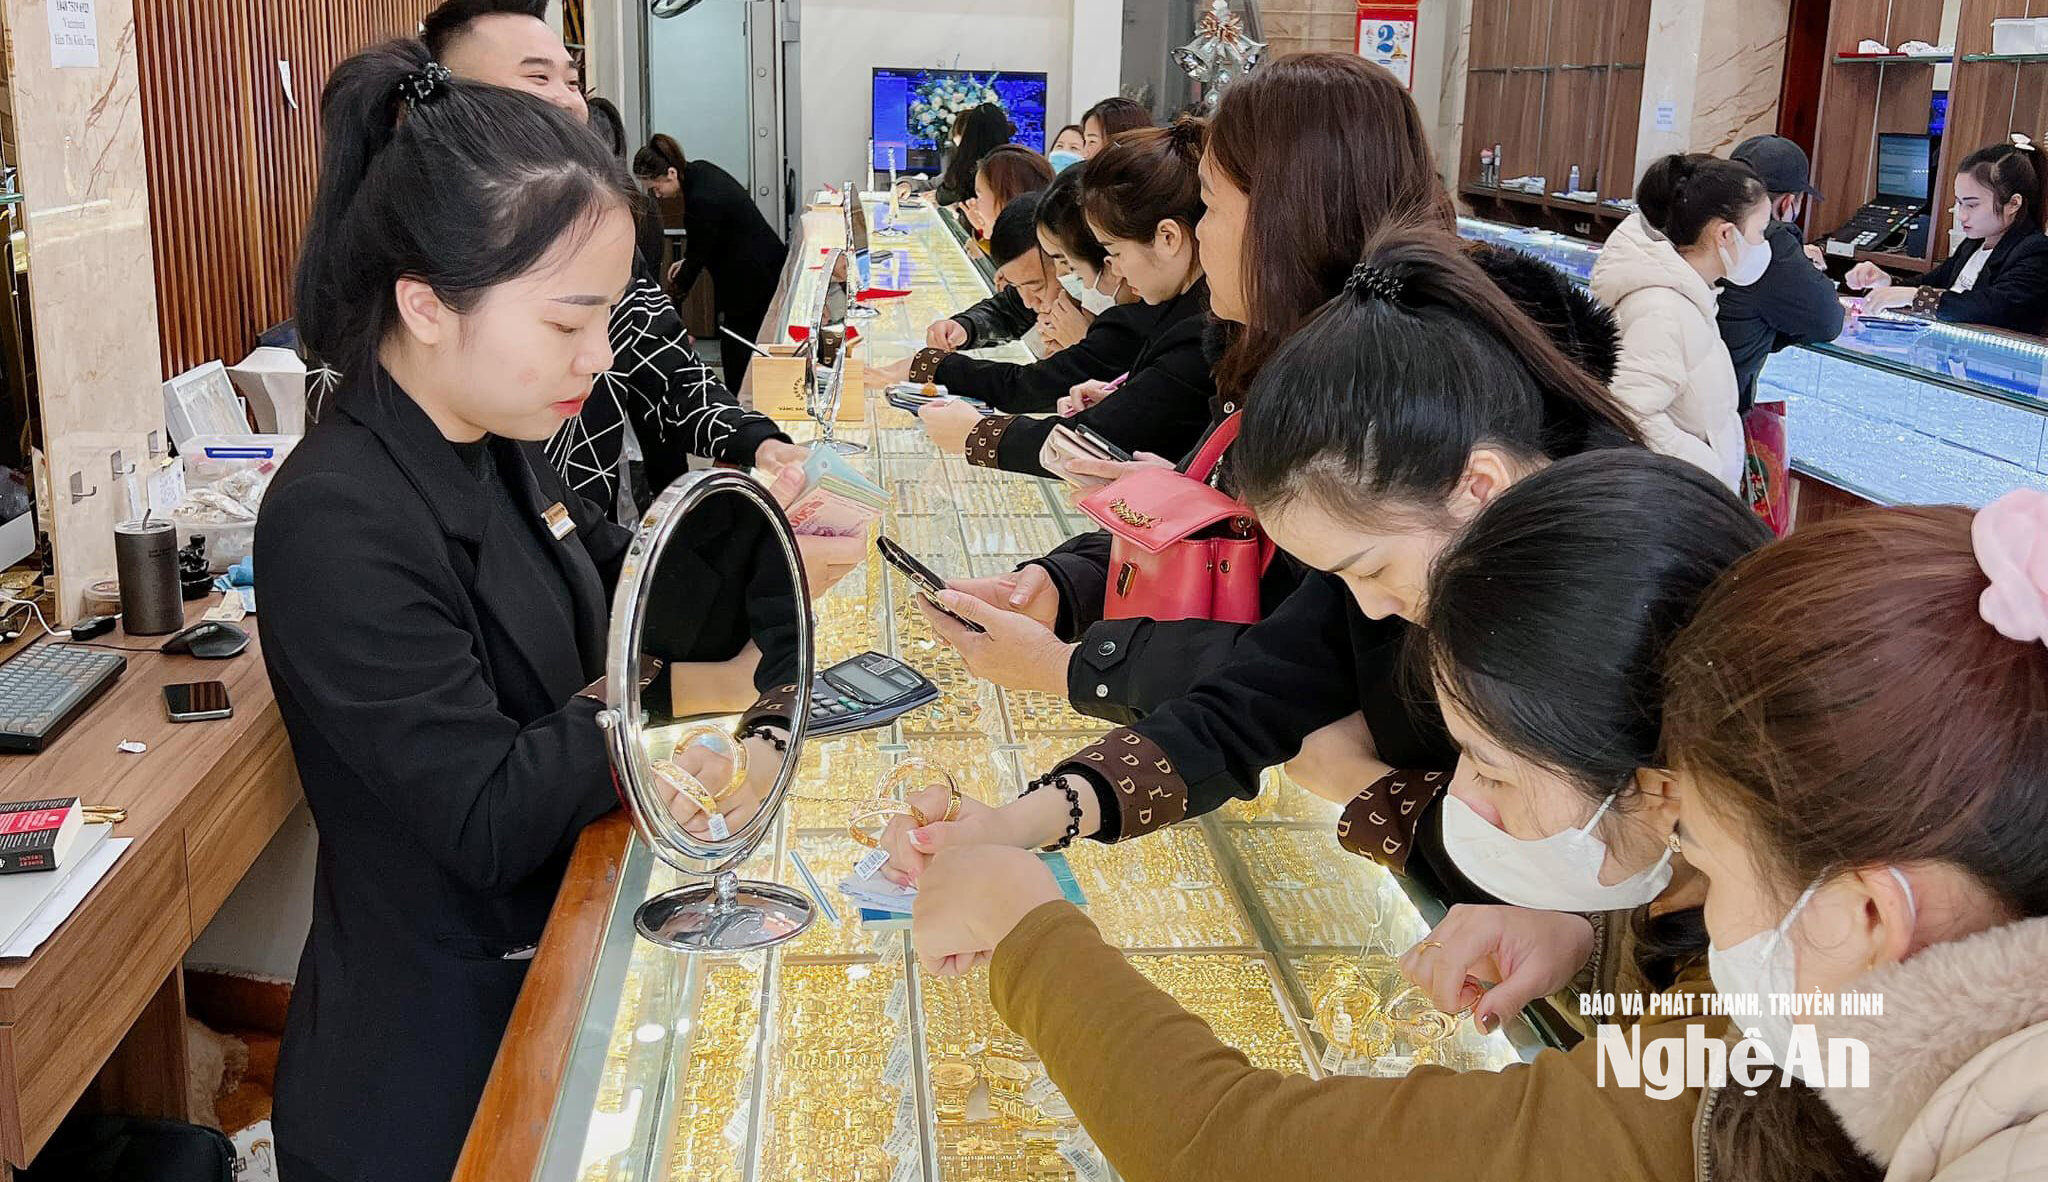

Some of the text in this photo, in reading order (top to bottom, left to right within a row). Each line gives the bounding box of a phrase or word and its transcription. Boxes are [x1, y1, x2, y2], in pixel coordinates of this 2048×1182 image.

[1376, 24, 1395, 53] 2
[1120, 734, 1141, 745] D
[1085, 752, 1105, 761] D
[1120, 753, 1139, 766] D
[1154, 757, 1171, 774] D
[1424, 772, 1442, 781] D
[1117, 776, 1136, 794] D
[1390, 781, 1407, 794] D
[1359, 789, 1375, 800] D
[1401, 799, 1416, 815] D
[1139, 807, 1152, 824] D
[1369, 811, 1387, 825] D
[1337, 820, 1352, 837] D
[1383, 836, 1402, 854] D
